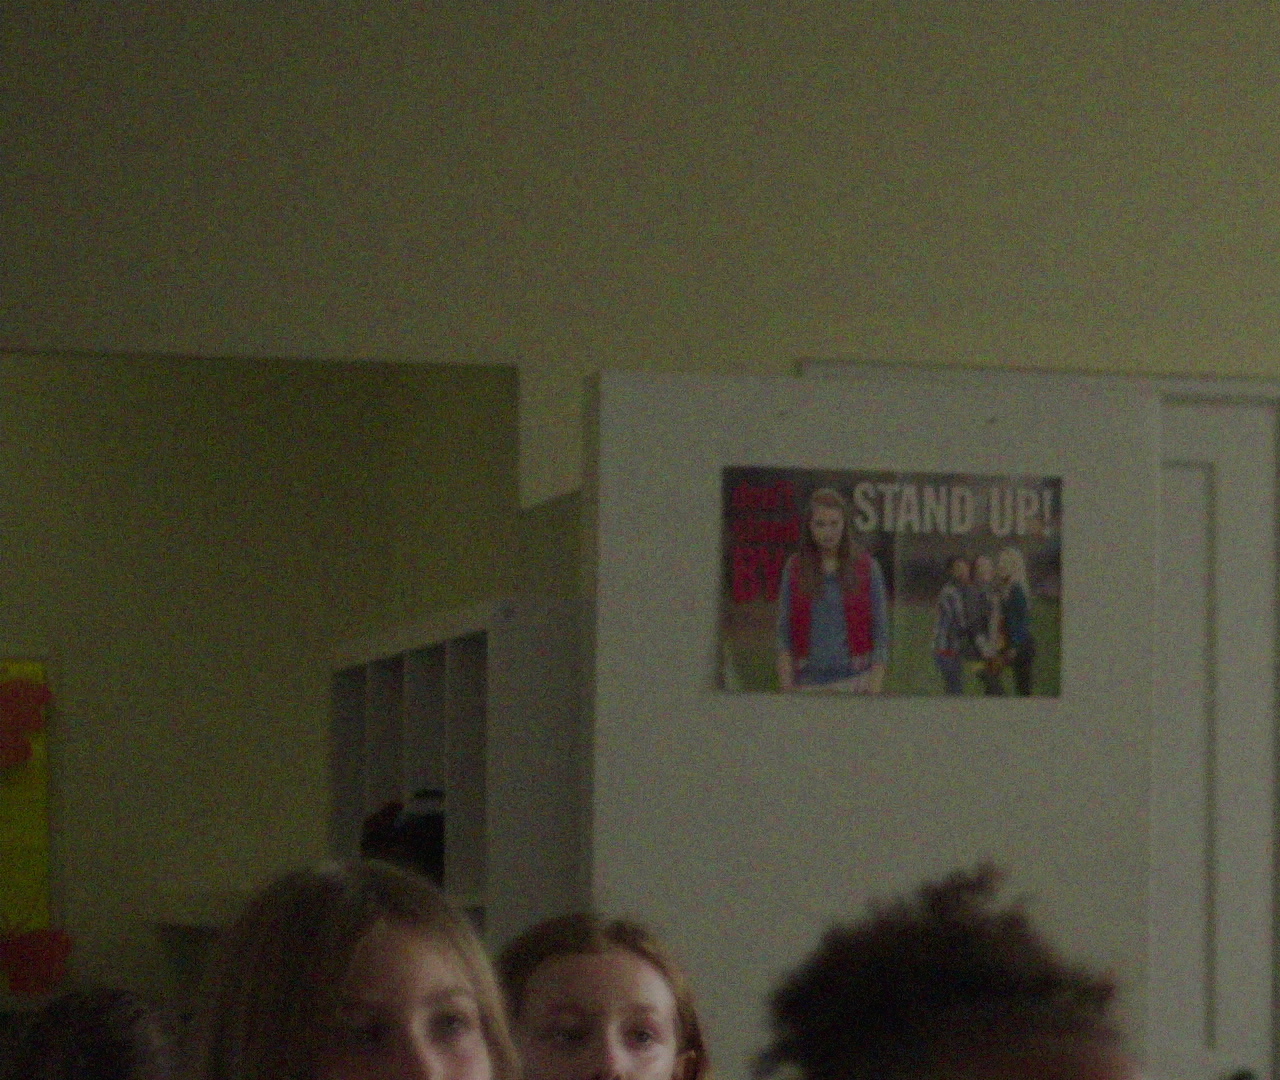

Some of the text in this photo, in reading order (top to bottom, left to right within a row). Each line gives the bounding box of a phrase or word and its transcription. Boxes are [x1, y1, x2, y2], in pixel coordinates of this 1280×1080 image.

[853, 481, 1054, 537] STAND UP!
[732, 547, 785, 604] BY
